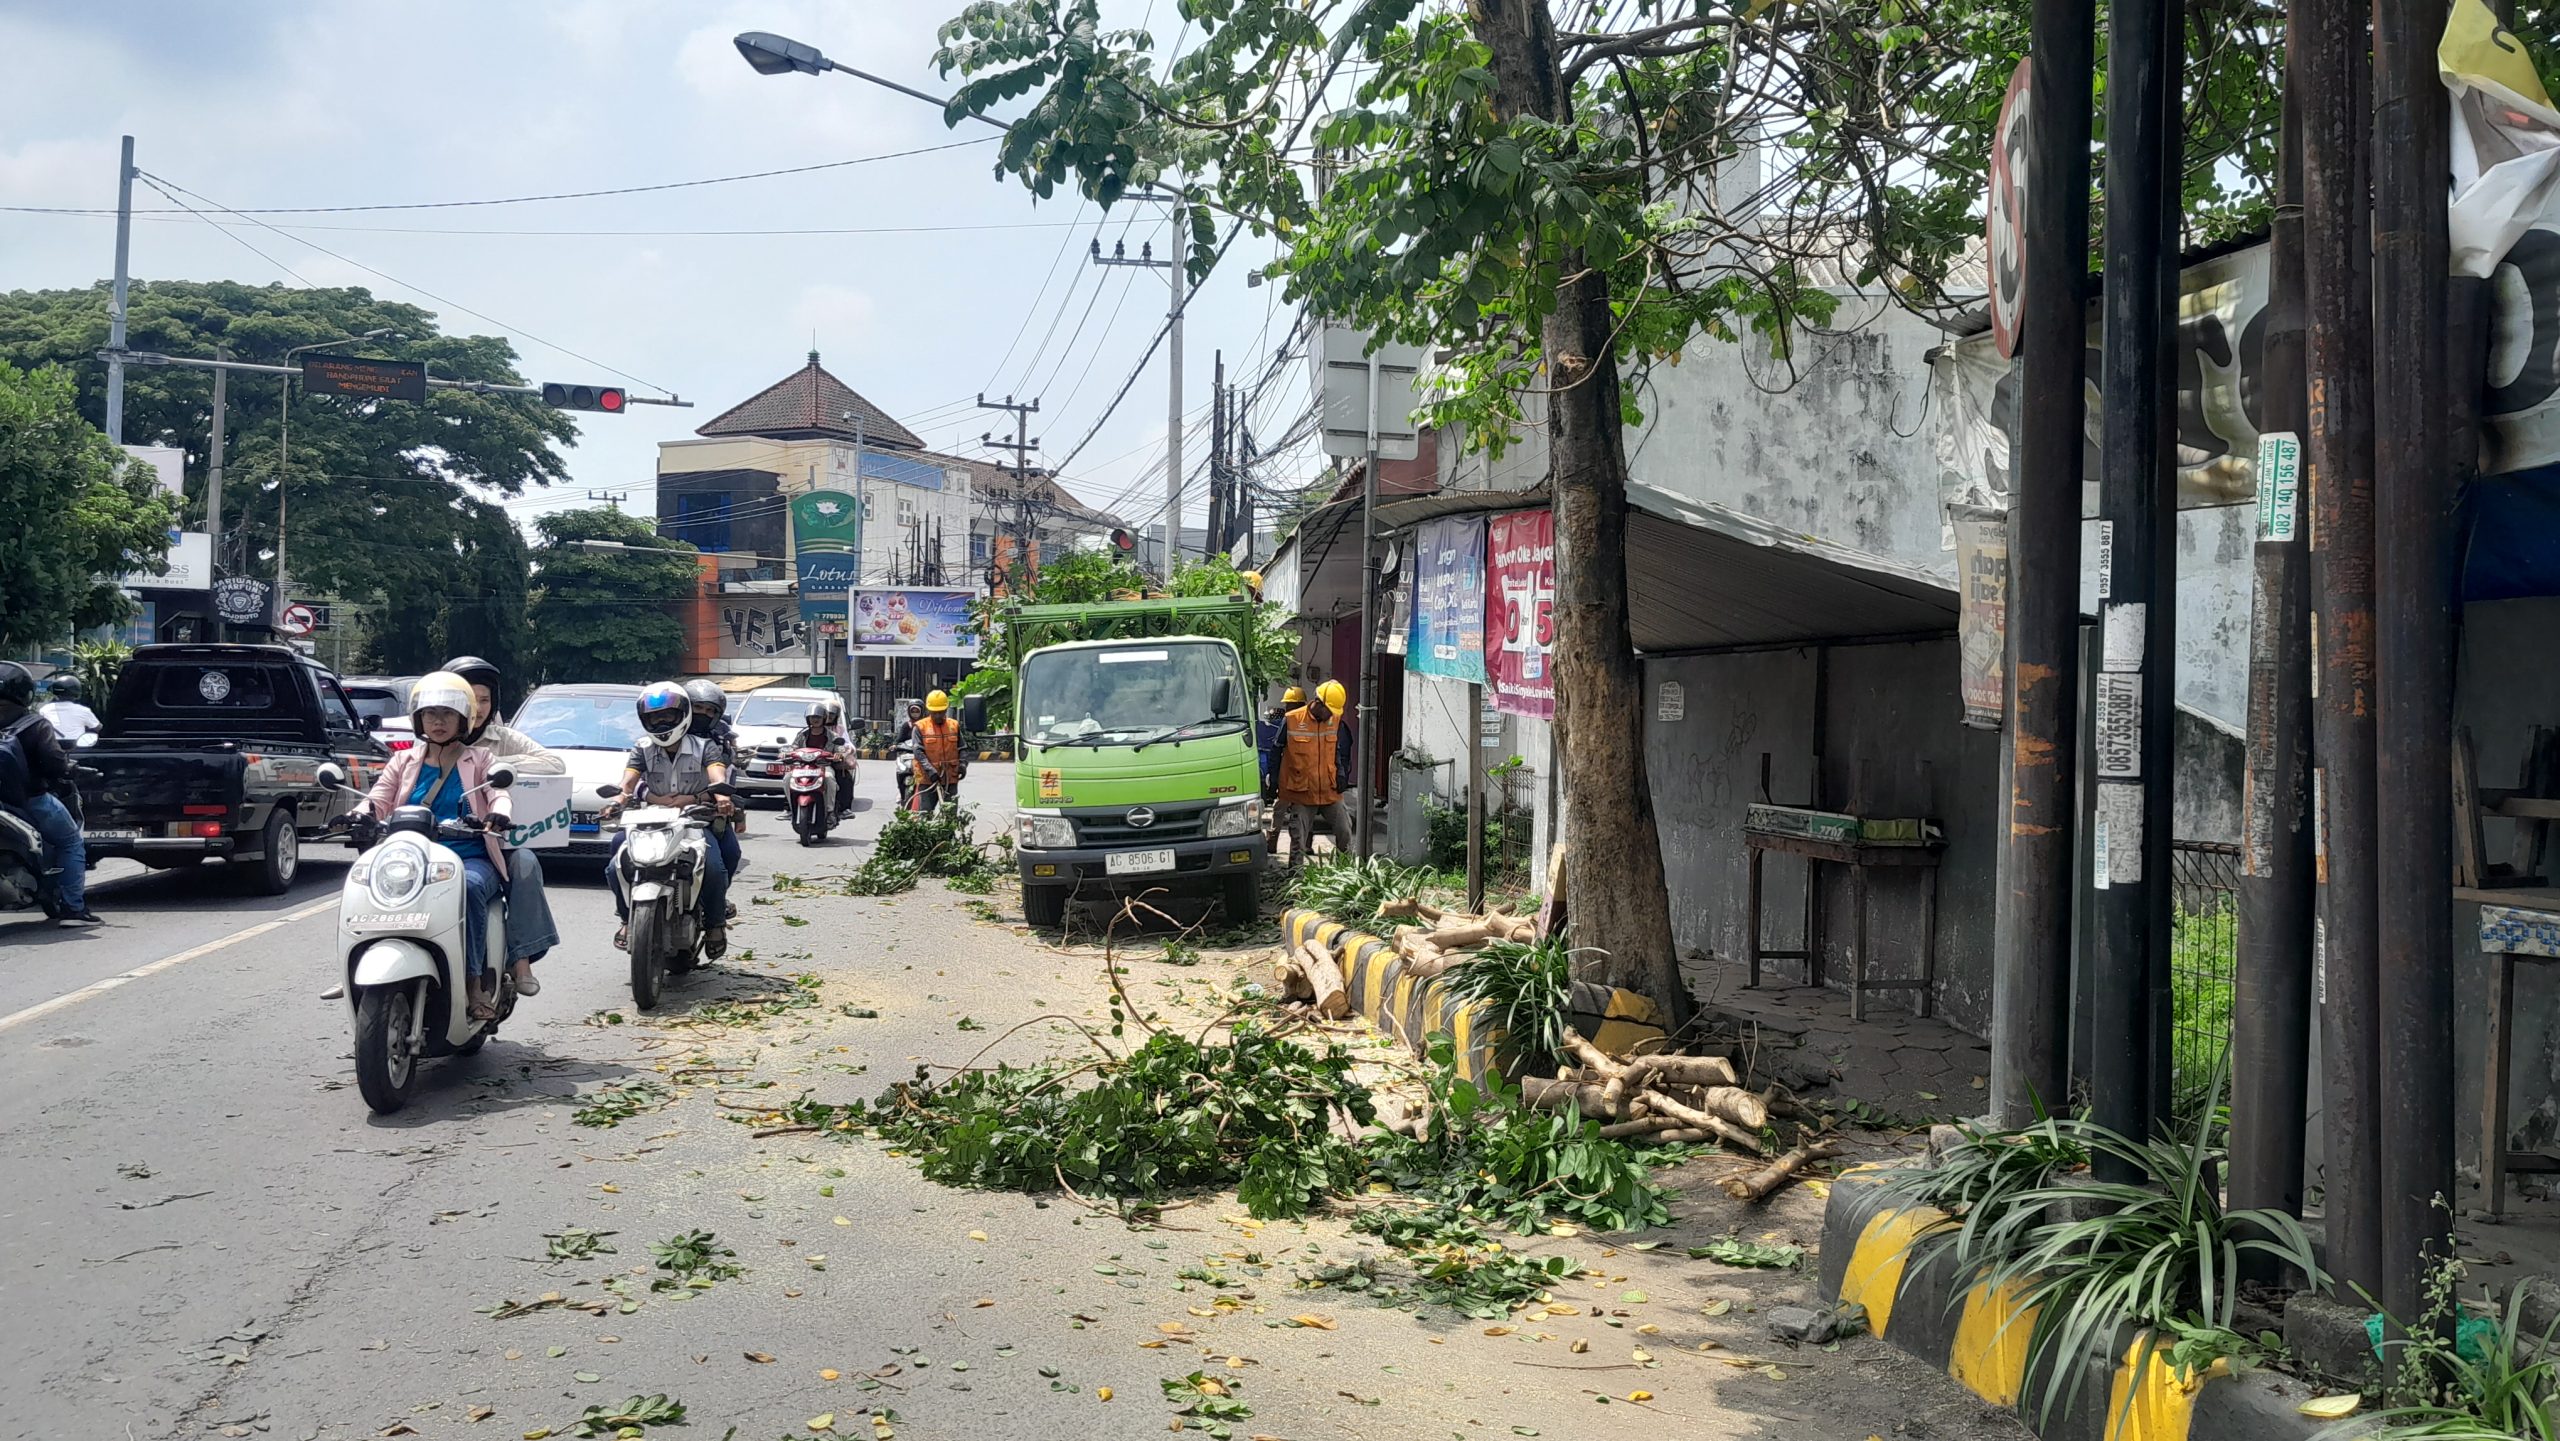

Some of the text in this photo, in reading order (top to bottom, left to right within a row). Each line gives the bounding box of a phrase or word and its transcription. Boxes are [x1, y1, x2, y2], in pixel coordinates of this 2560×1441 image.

[338, 382, 390, 393] MENGEMUDI
[2281, 440, 2297, 461] 487
[2278, 464, 2295, 485] 156
[2275, 513, 2291, 534] 082
[2101, 525, 2111, 546] 8877
[2100, 548, 2110, 570] 3555
[801, 564, 855, 581] Lotus
[1209, 785, 1237, 794] 300
[1128, 852, 1153, 866] 8506
